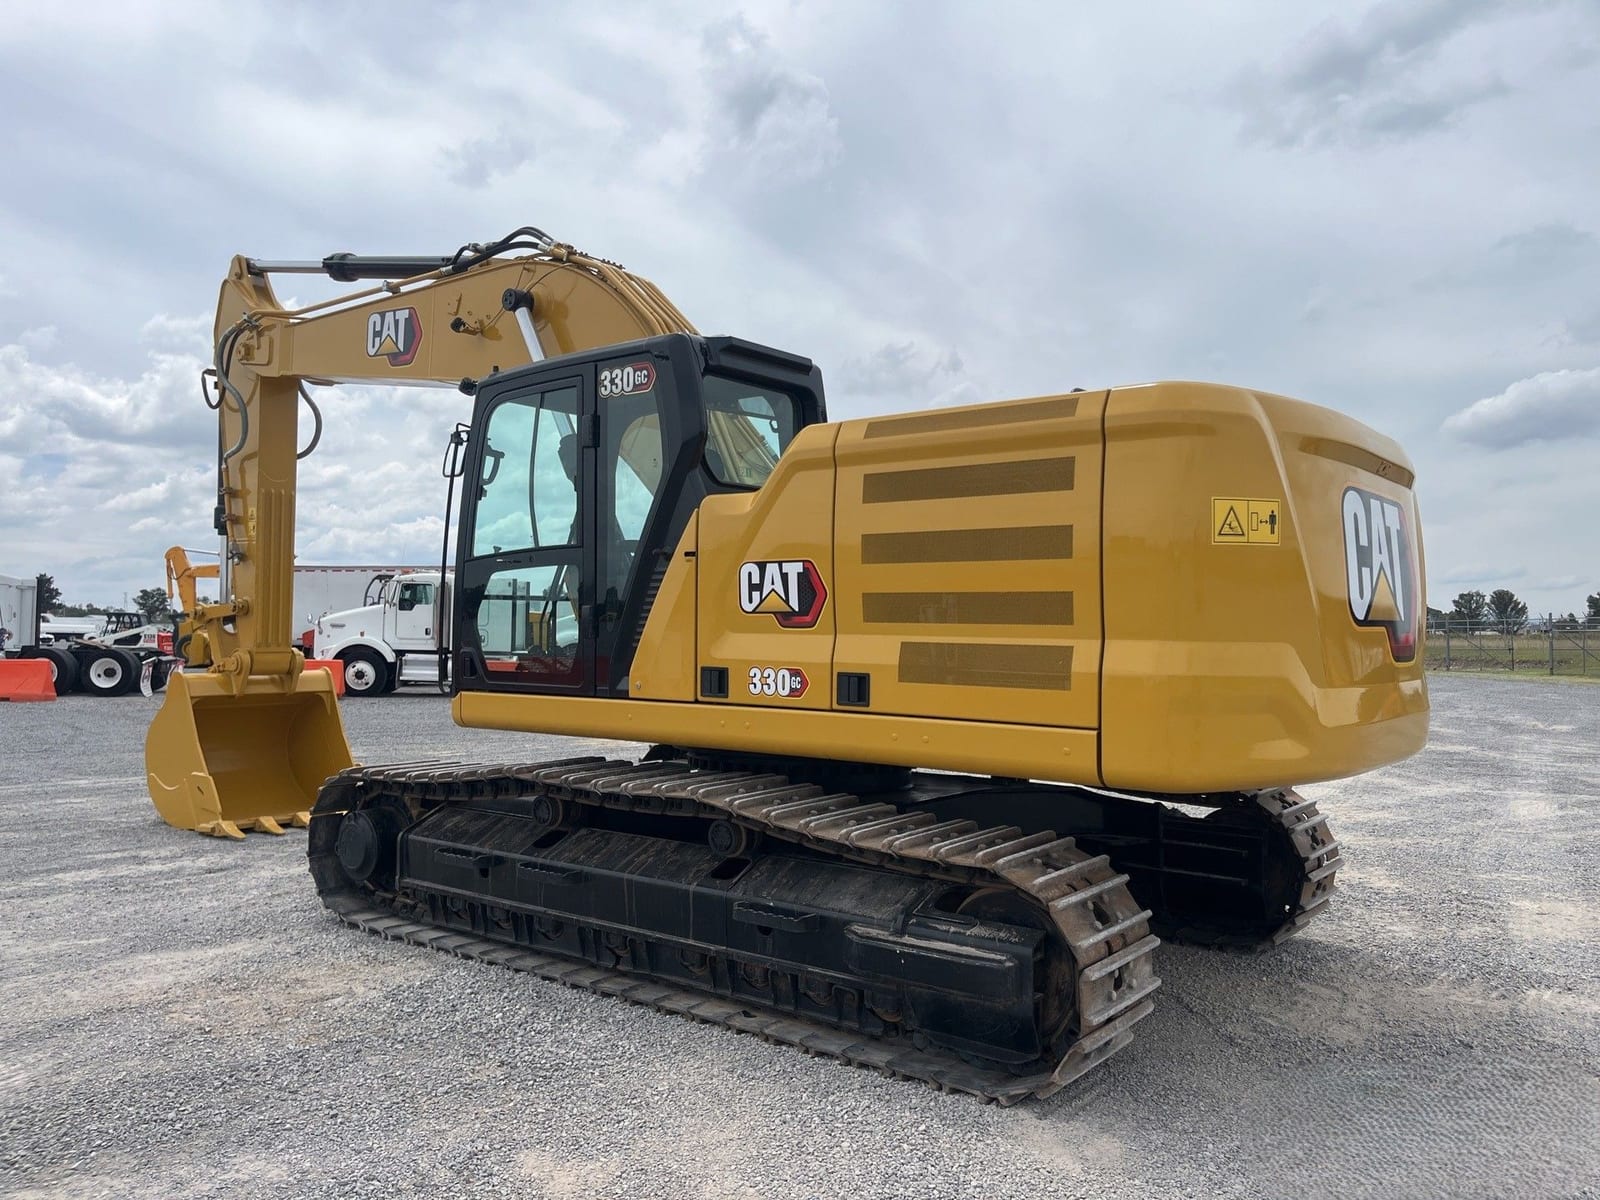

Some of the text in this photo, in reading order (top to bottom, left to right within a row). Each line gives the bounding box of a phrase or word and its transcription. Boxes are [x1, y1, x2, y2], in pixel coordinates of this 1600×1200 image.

[367, 309, 410, 356] CAT
[1342, 490, 1405, 622] CAT
[740, 562, 804, 612] CAT
